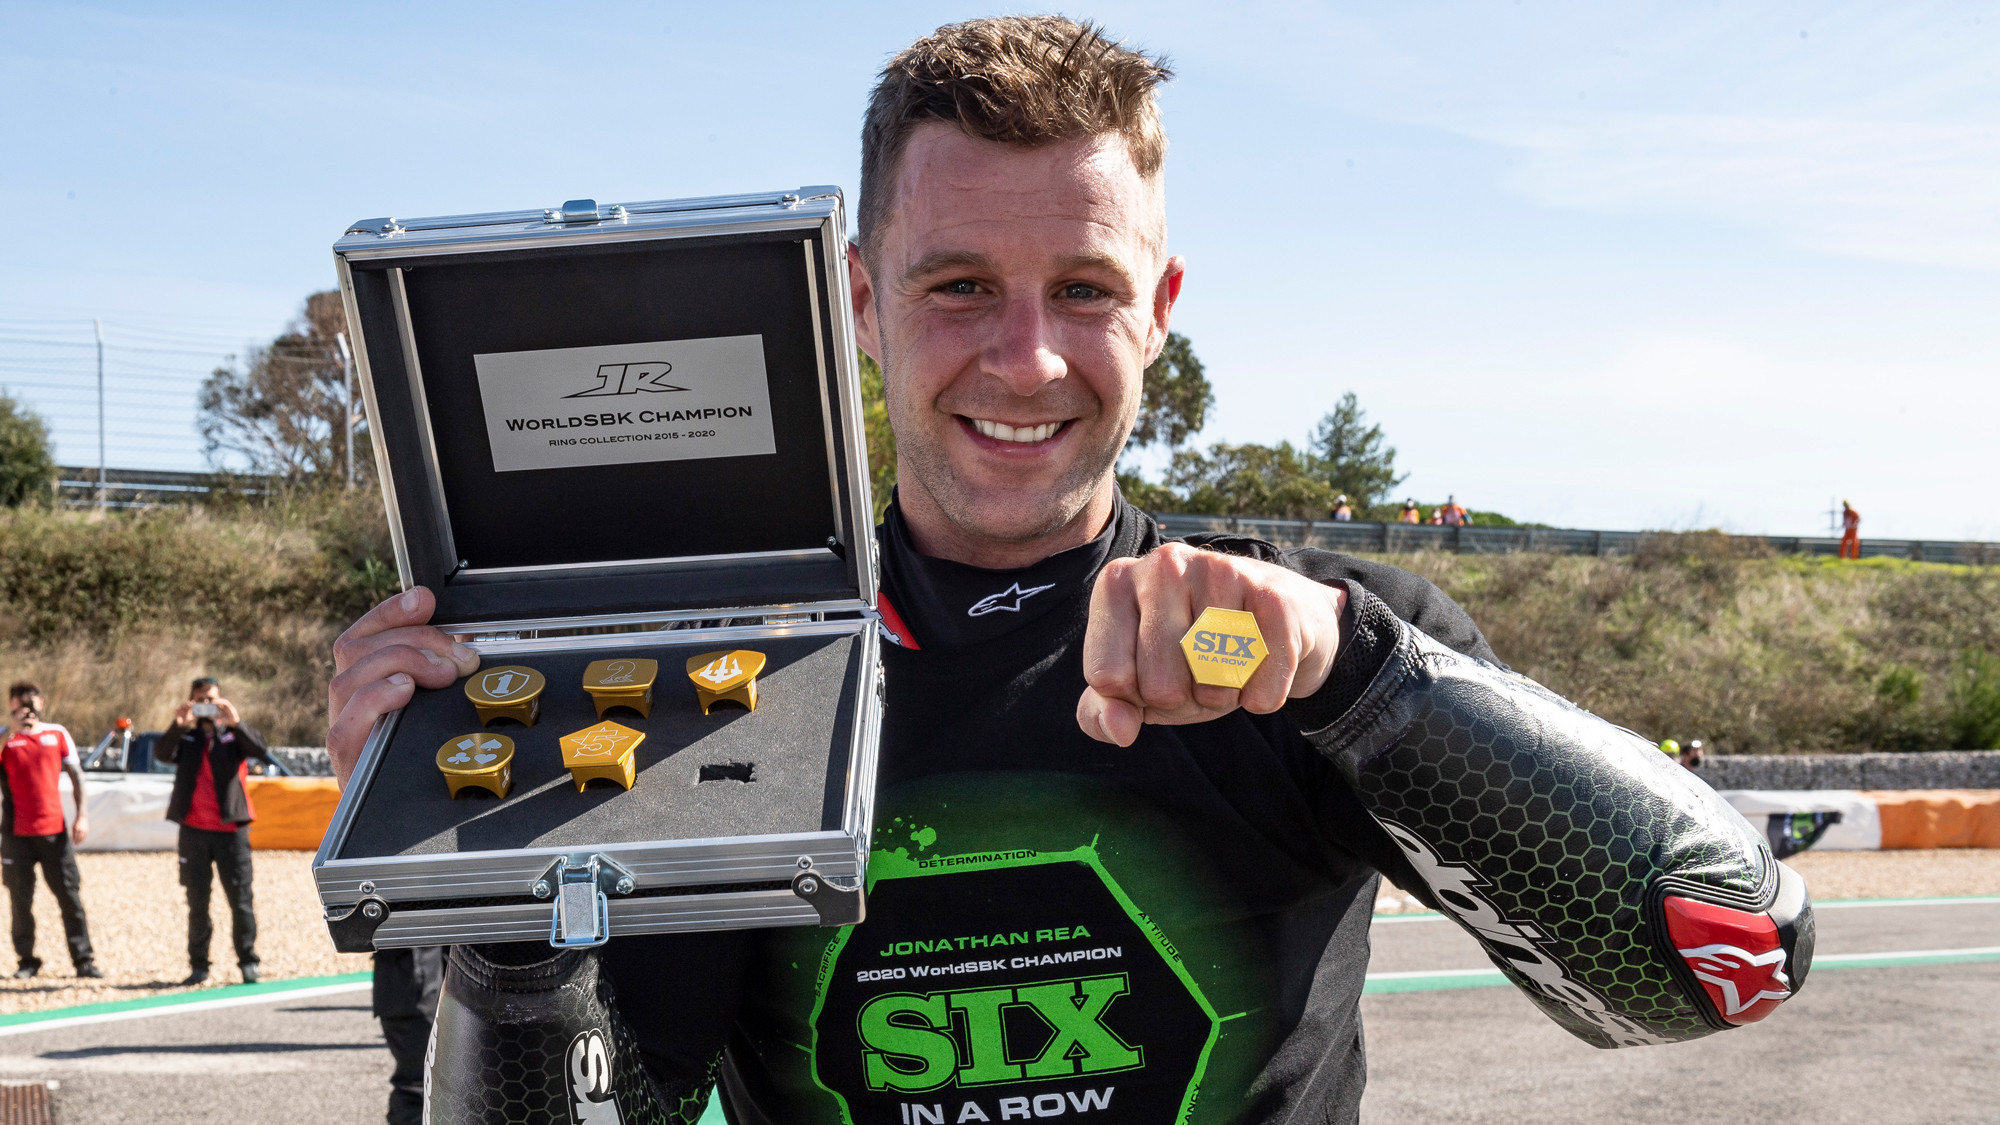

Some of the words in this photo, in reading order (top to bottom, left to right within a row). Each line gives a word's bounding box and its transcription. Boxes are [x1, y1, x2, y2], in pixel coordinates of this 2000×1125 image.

[560, 361, 692, 399] JR
[549, 438, 577, 447] RING
[579, 433, 652, 446] COLLECTION
[654, 432, 679, 441] 2015
[688, 430, 716, 439] 2020
[1193, 630, 1256, 659] SIX
[1198, 654, 1209, 662] IN
[1221, 658, 1248, 667] ROW
[491, 674, 514, 694] 1
[918, 849, 1037, 869] DETERMINATION
[880, 930, 1030, 957] JONATHAN
[1036, 925, 1092, 942] REA
[1137, 911, 1182, 963] ATTITUDE
[815, 936, 842, 997] SACRIFICE
[856, 967, 905, 983] 2020
[909, 959, 1007, 978] WorldSBK
[1010, 946, 1123, 969] CHAMPION
[857, 972, 1145, 1092] SIX
[901, 1101, 944, 1125] IN
[956, 1100, 990, 1124] A
[1000, 1087, 1115, 1120] ROW
